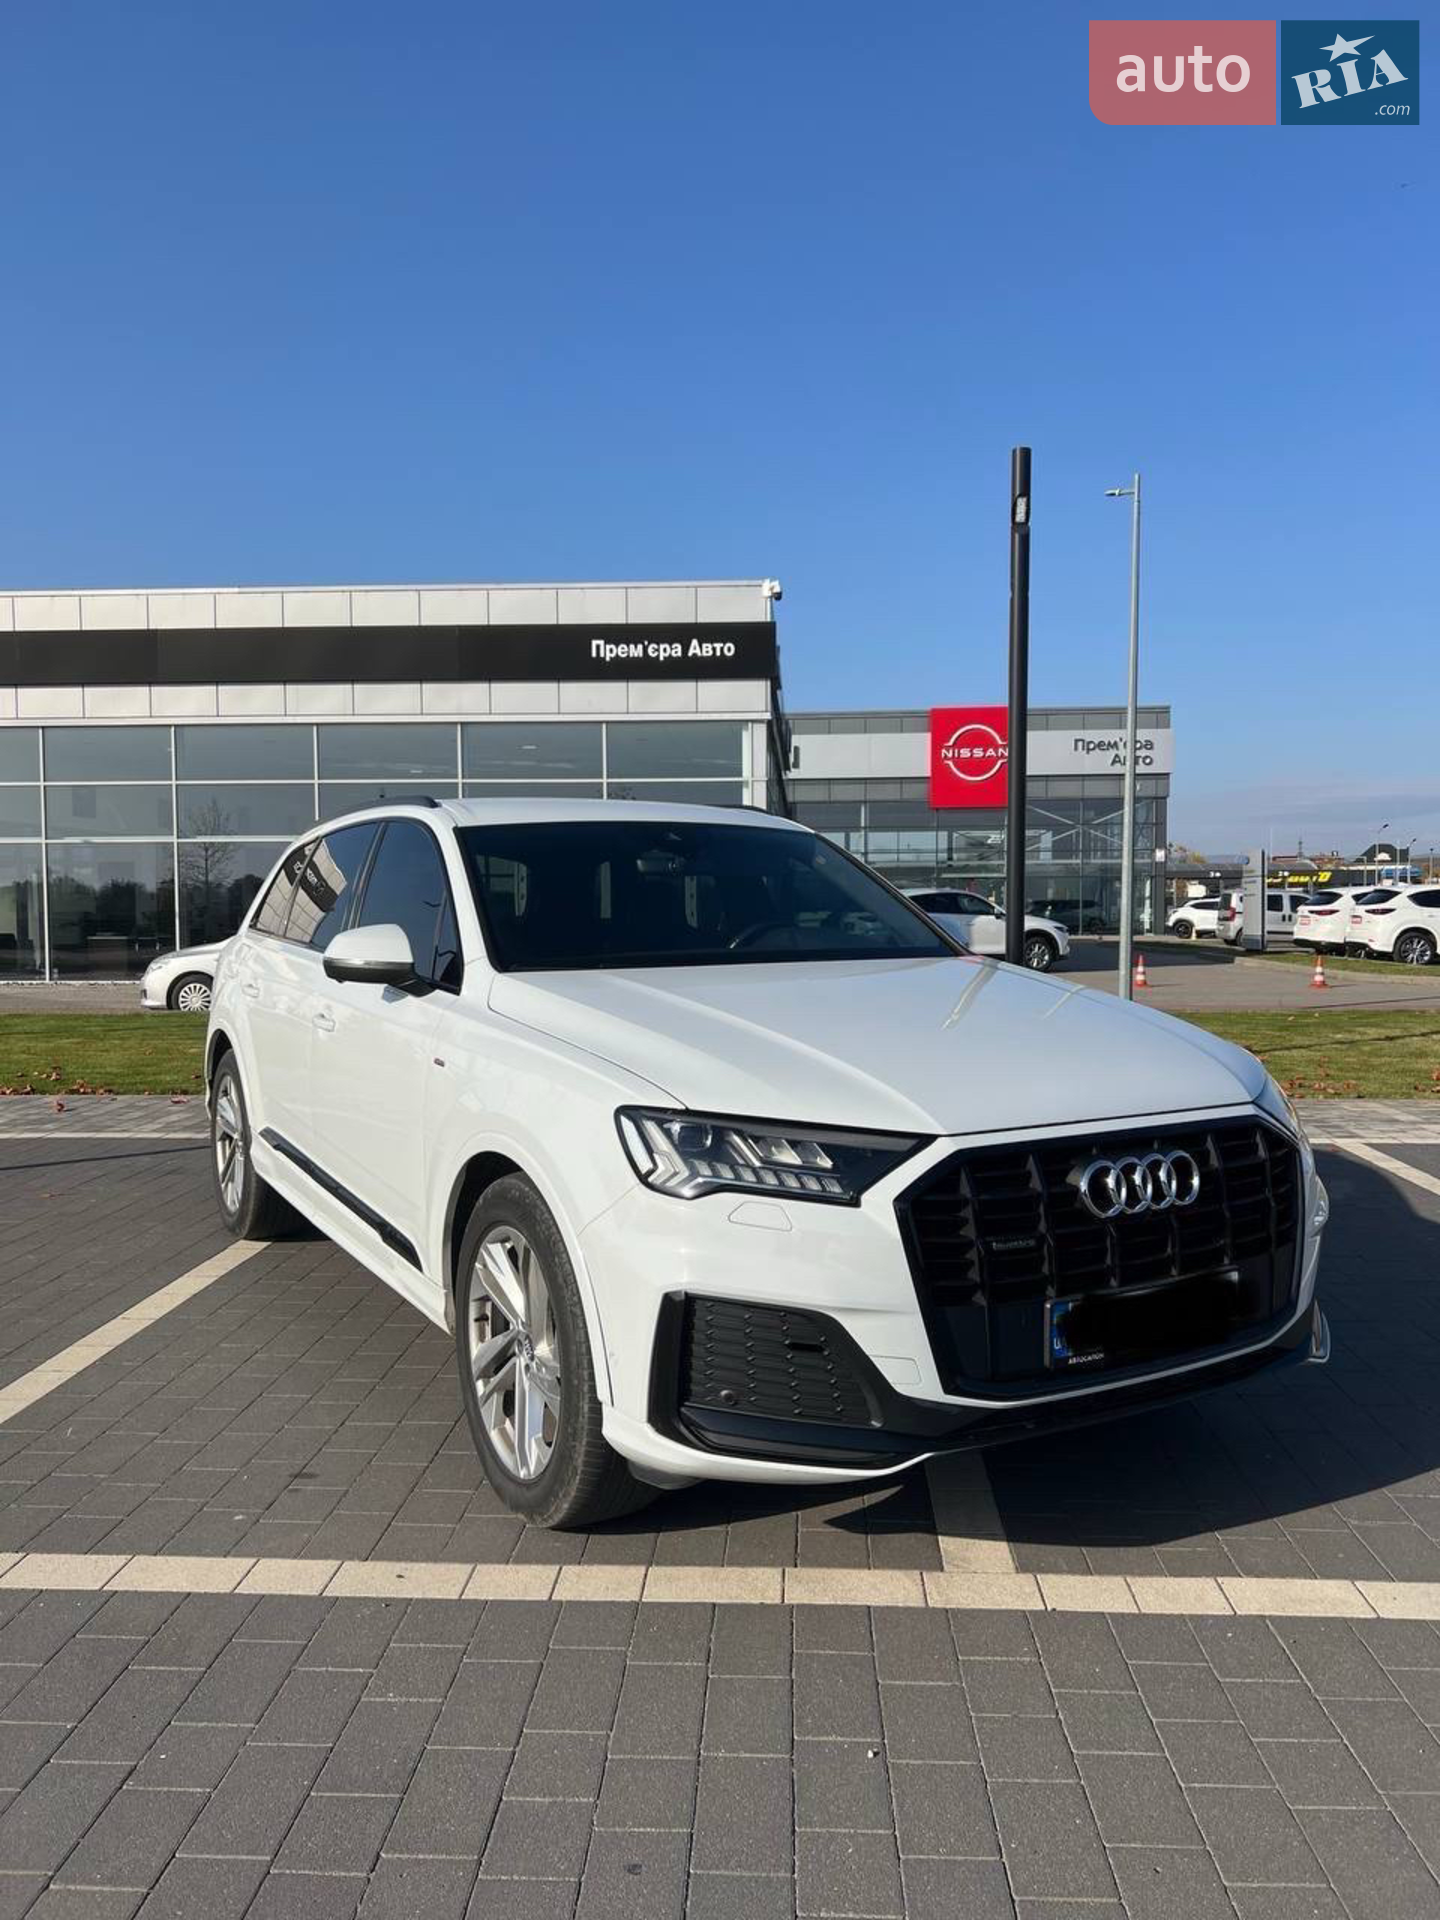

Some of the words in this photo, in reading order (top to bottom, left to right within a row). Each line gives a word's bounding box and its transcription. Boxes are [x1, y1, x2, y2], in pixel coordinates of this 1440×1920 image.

[590, 639, 682, 662] Прем'єра
[687, 639, 735, 657] Авто
[941, 746, 1009, 760] NISSAN
